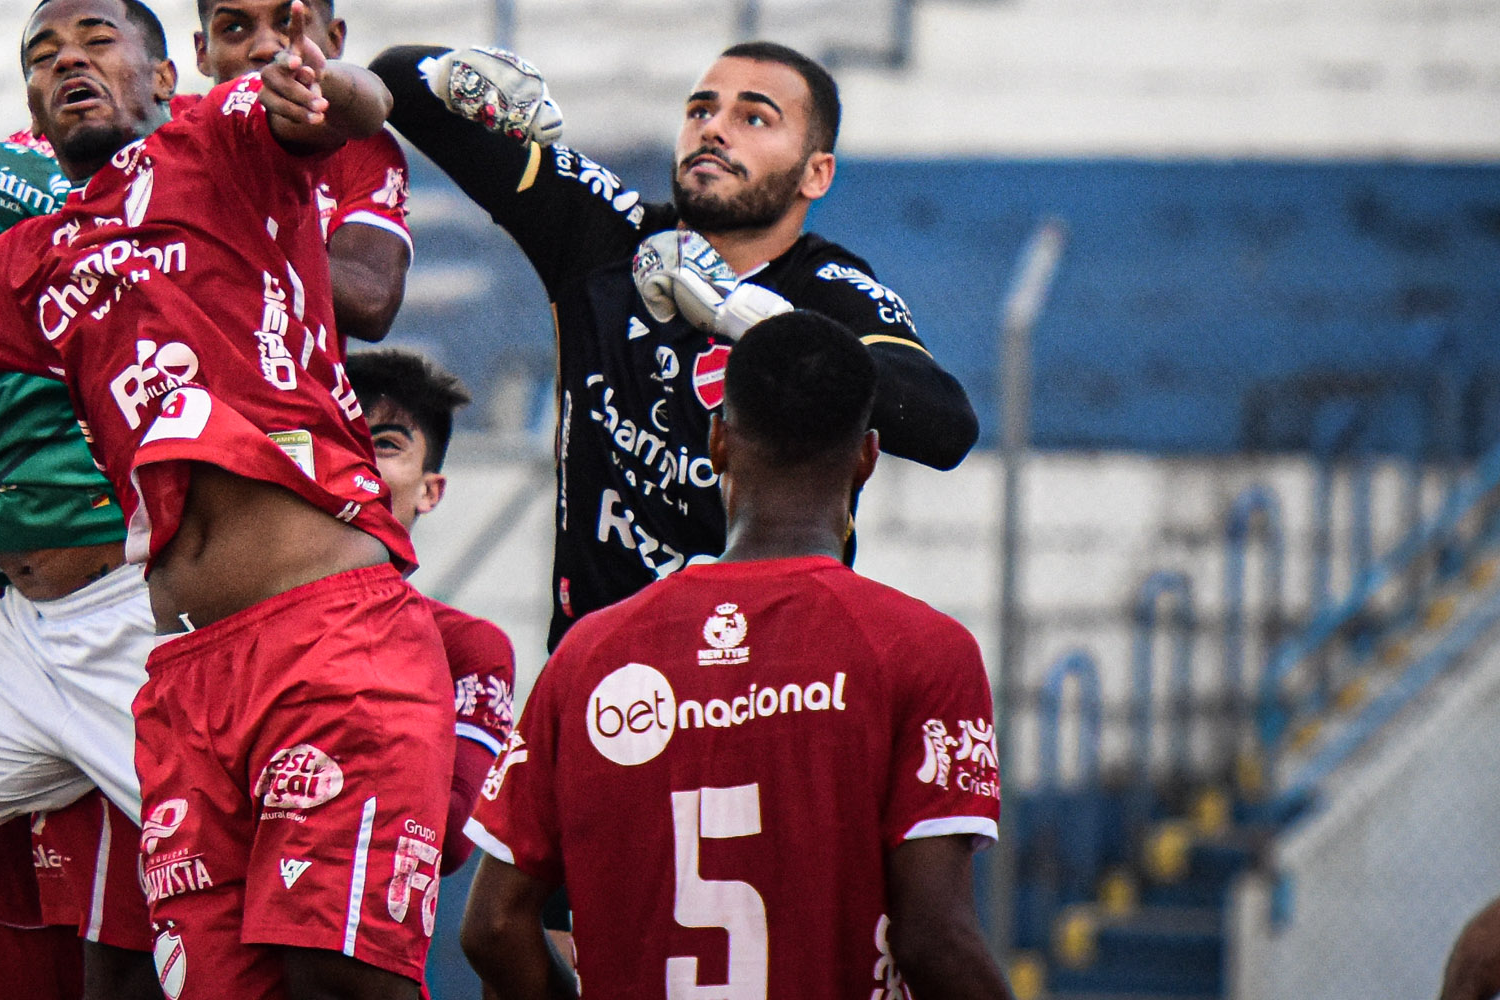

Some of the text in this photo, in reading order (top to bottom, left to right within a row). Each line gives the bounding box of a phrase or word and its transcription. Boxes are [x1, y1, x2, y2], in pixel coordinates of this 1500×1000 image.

[594, 672, 847, 738] bet nacional
[404, 819, 436, 842] Grupo
[665, 783, 770, 1000] 5
